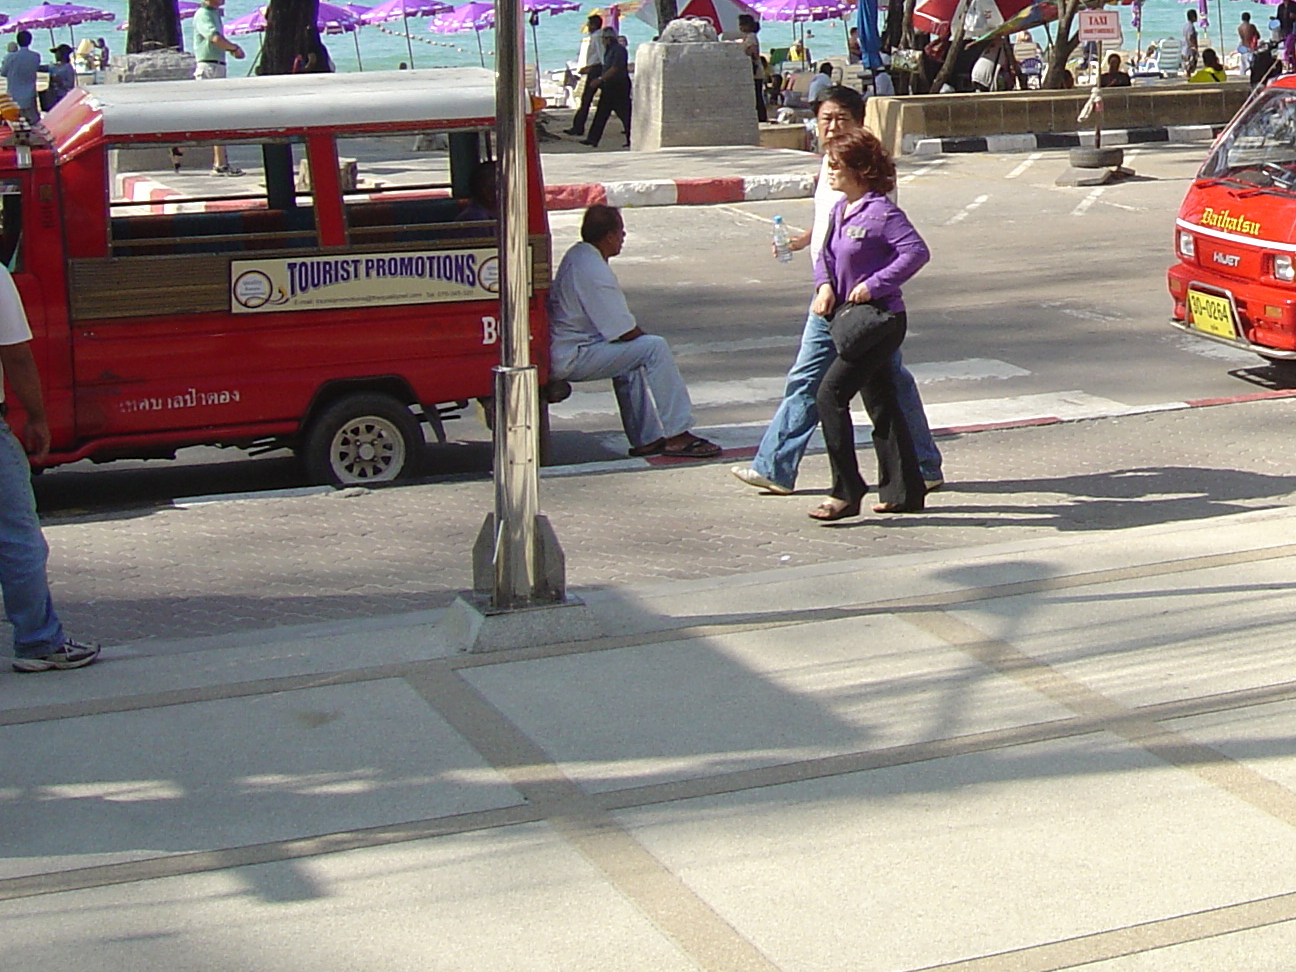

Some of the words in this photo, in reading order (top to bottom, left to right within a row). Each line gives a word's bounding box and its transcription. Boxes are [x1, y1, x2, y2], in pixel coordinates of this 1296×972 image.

[1088, 15, 1107, 26] TAXI
[1201, 207, 1261, 235] Daihatsu
[287, 259, 361, 297] TOURIST
[365, 253, 477, 287] PROMOTIONS
